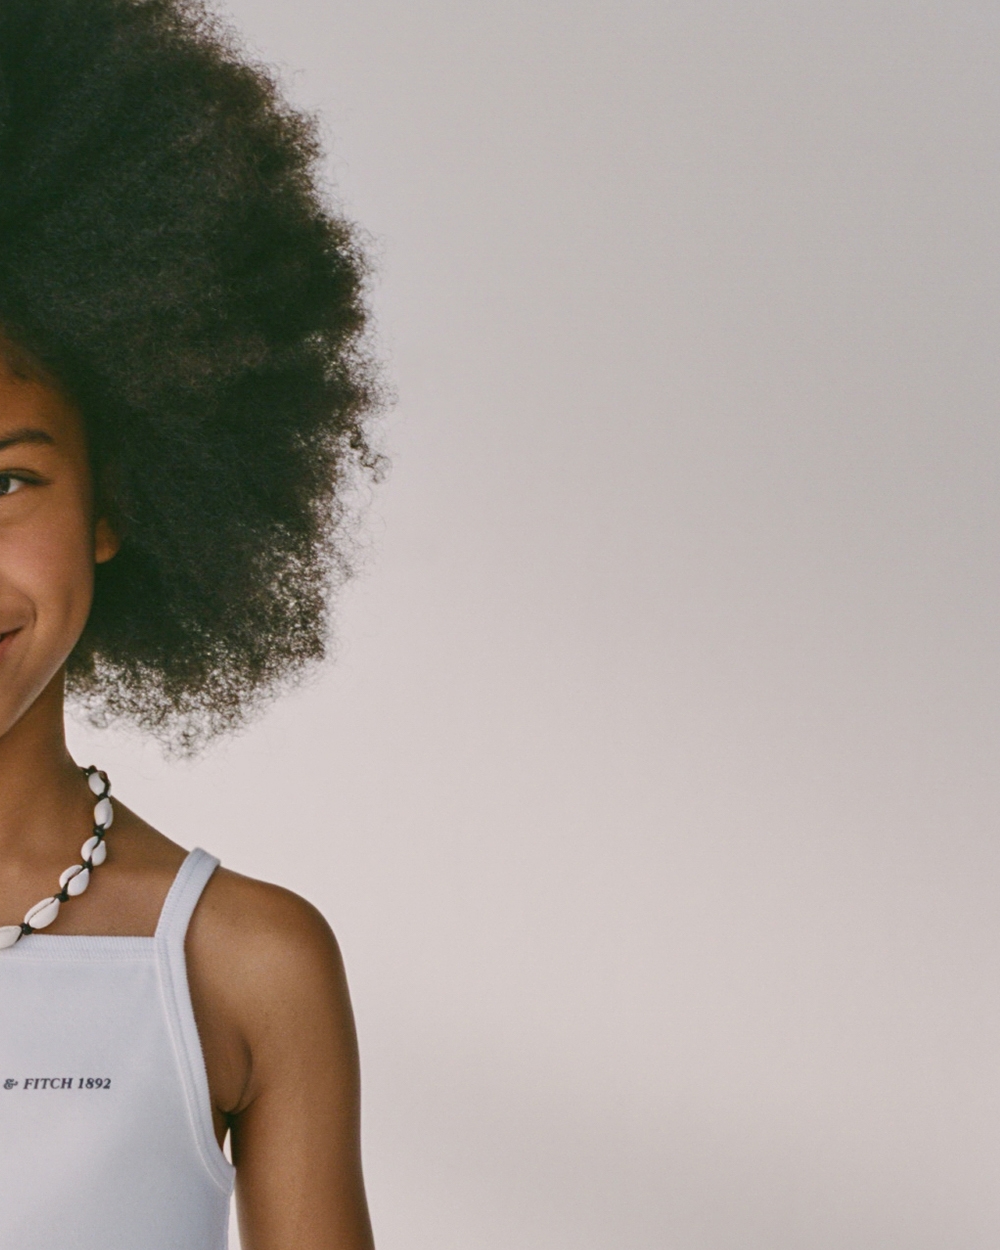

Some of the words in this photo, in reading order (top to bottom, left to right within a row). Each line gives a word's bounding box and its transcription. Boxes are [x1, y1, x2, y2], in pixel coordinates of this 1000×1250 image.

[2, 1078, 19, 1090] &
[22, 1077, 74, 1090] FITCH
[77, 1077, 112, 1090] 1892
